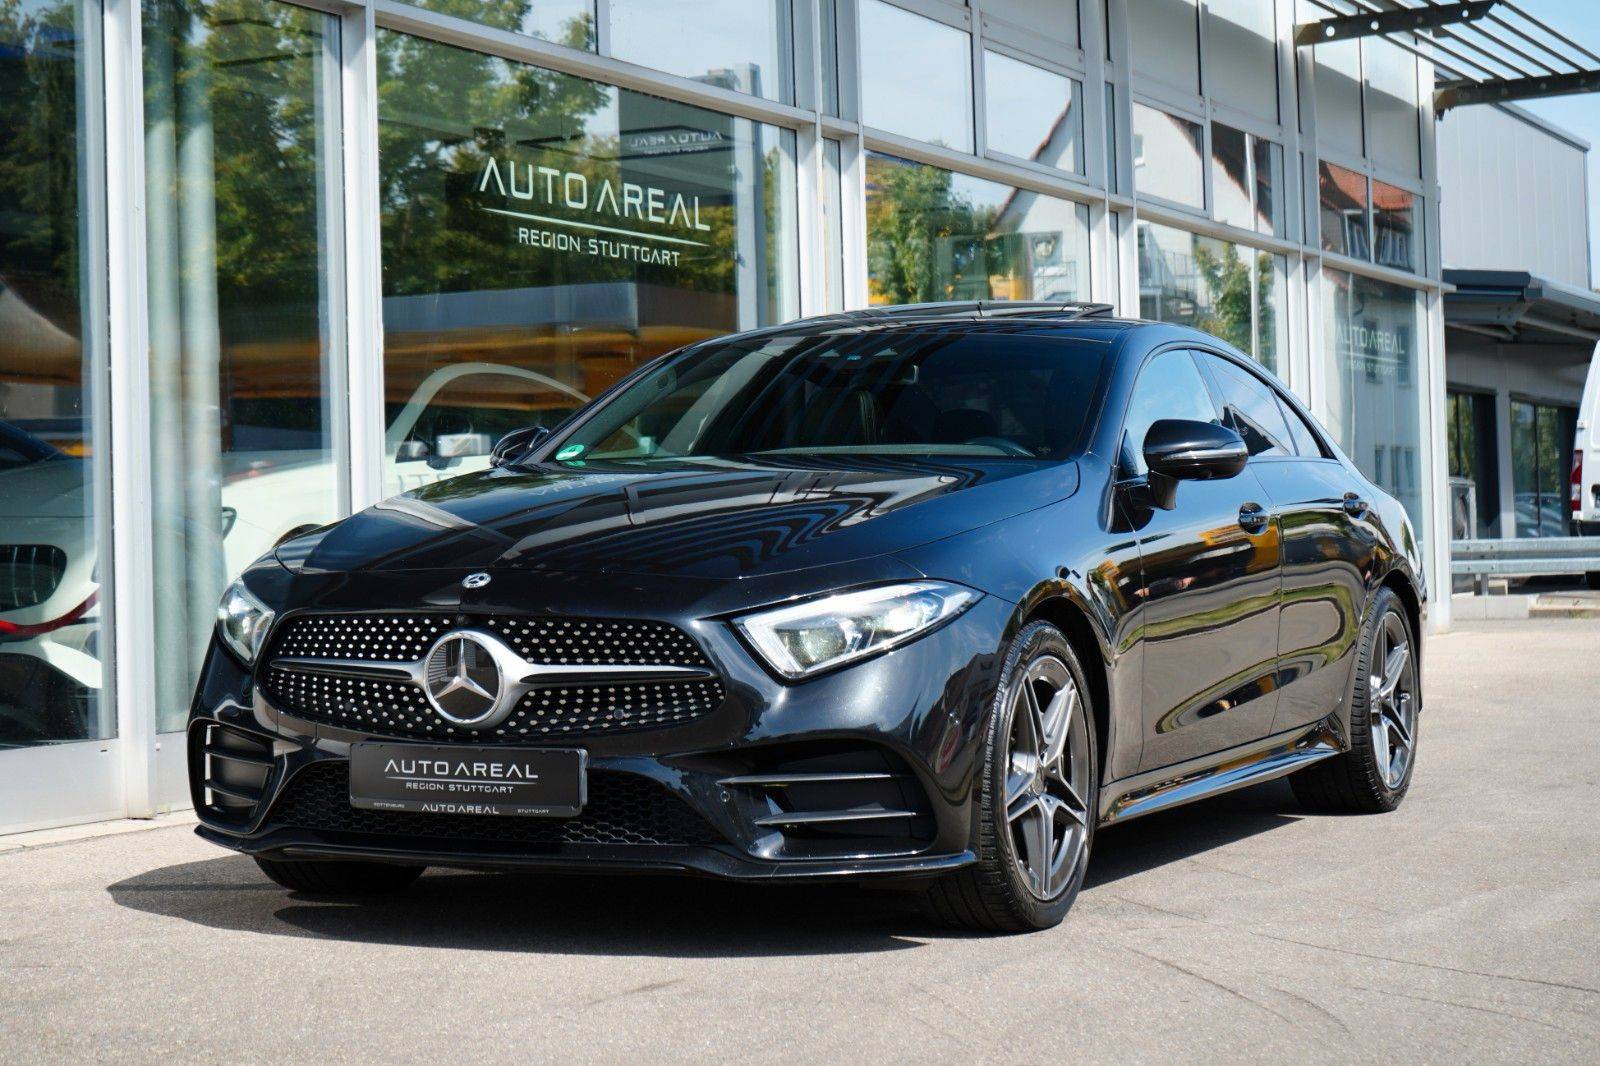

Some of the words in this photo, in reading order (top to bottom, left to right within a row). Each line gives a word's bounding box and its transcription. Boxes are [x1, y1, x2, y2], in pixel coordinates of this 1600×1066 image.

[479, 156, 711, 232] AUTOAREAL
[518, 227, 581, 253] REGION
[588, 238, 681, 267] STUTTGART
[384, 758, 539, 779] AUTOAREAL
[405, 781, 445, 791] REGION
[448, 784, 514, 795] STUTTGART
[421, 803, 500, 815] AUTOAREAL
